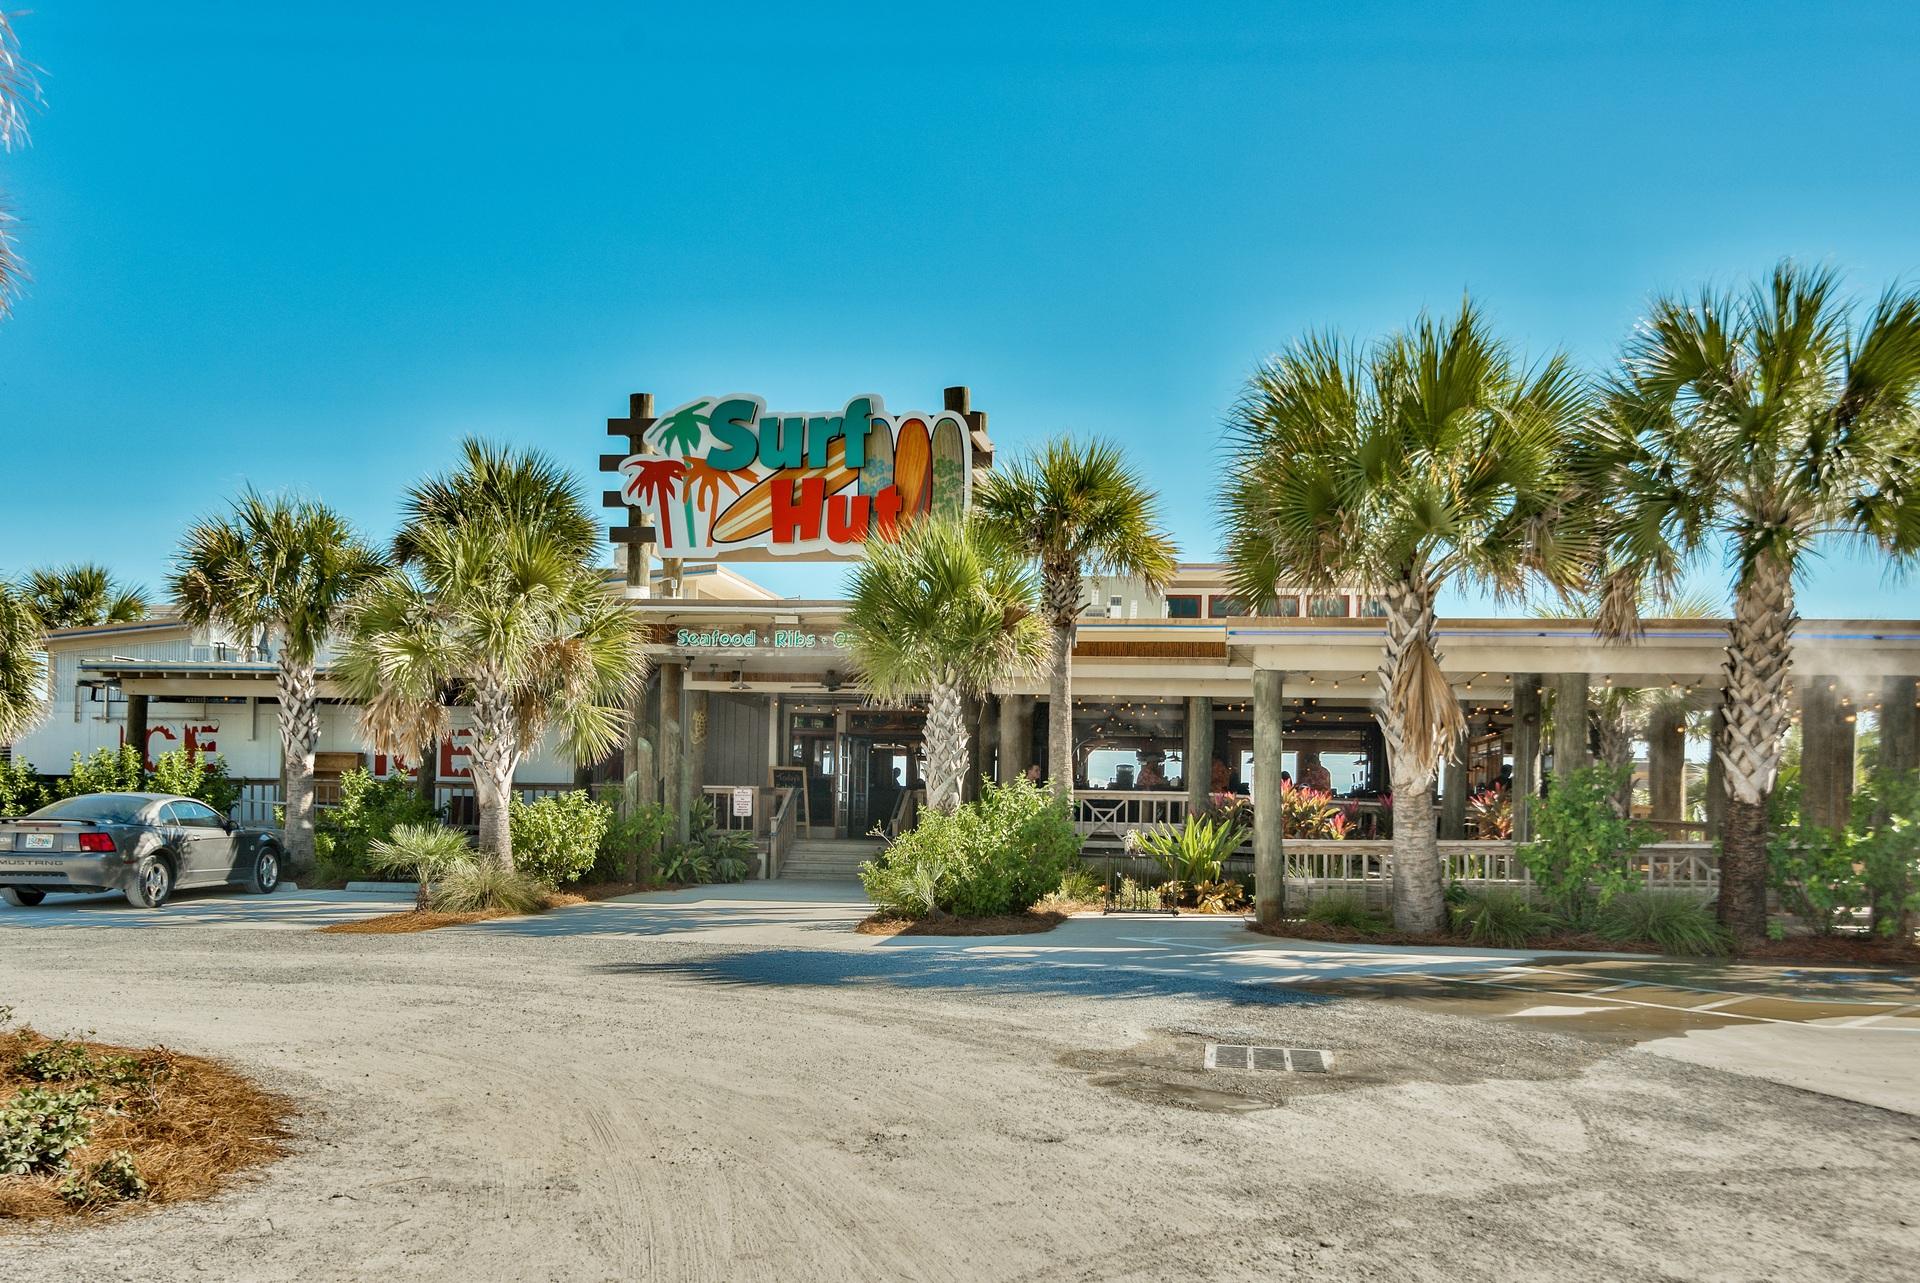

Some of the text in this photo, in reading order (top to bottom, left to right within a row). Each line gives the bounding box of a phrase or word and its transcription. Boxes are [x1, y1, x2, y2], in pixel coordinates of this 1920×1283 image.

[706, 398, 873, 471] Surf
[770, 477, 902, 544] Hut
[677, 629, 756, 647] Seafood
[774, 630, 816, 648] Ribs
